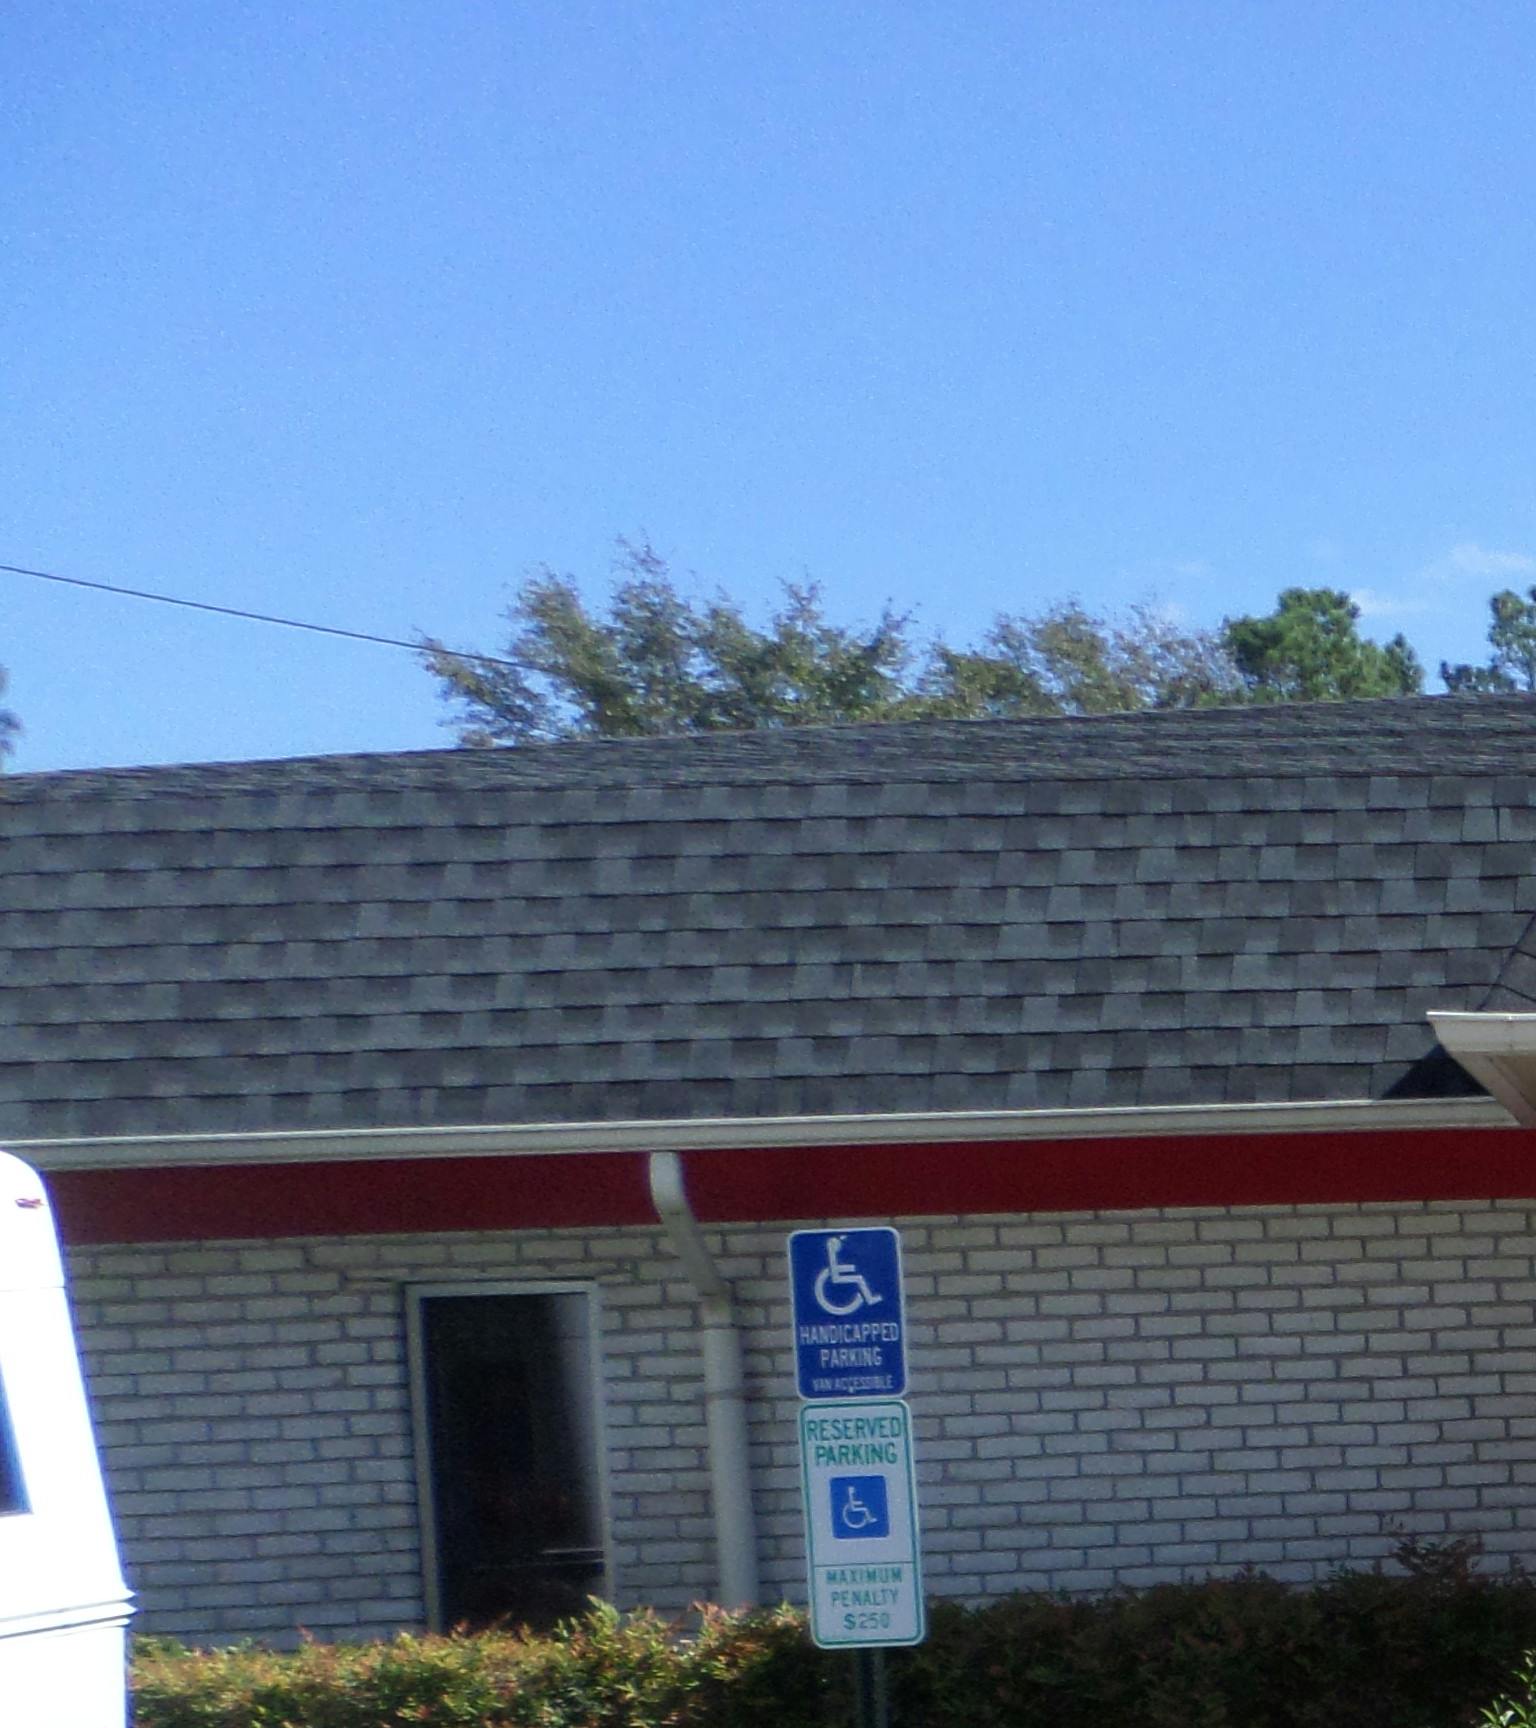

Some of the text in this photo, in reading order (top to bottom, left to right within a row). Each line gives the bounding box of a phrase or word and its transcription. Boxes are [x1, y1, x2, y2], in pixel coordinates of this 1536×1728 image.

[799, 1323, 899, 1344] HANDICAPPED
[821, 1347, 882, 1368] PARKING
[813, 1375, 894, 1392] VAN ACCESSIBLE
[807, 1417, 901, 1441] RESERVED
[815, 1443, 898, 1466] PARKING
[827, 1568, 902, 1584] MAXIMUM
[832, 1590, 898, 1607] PENALTY
[844, 1613, 889, 1630] $250
